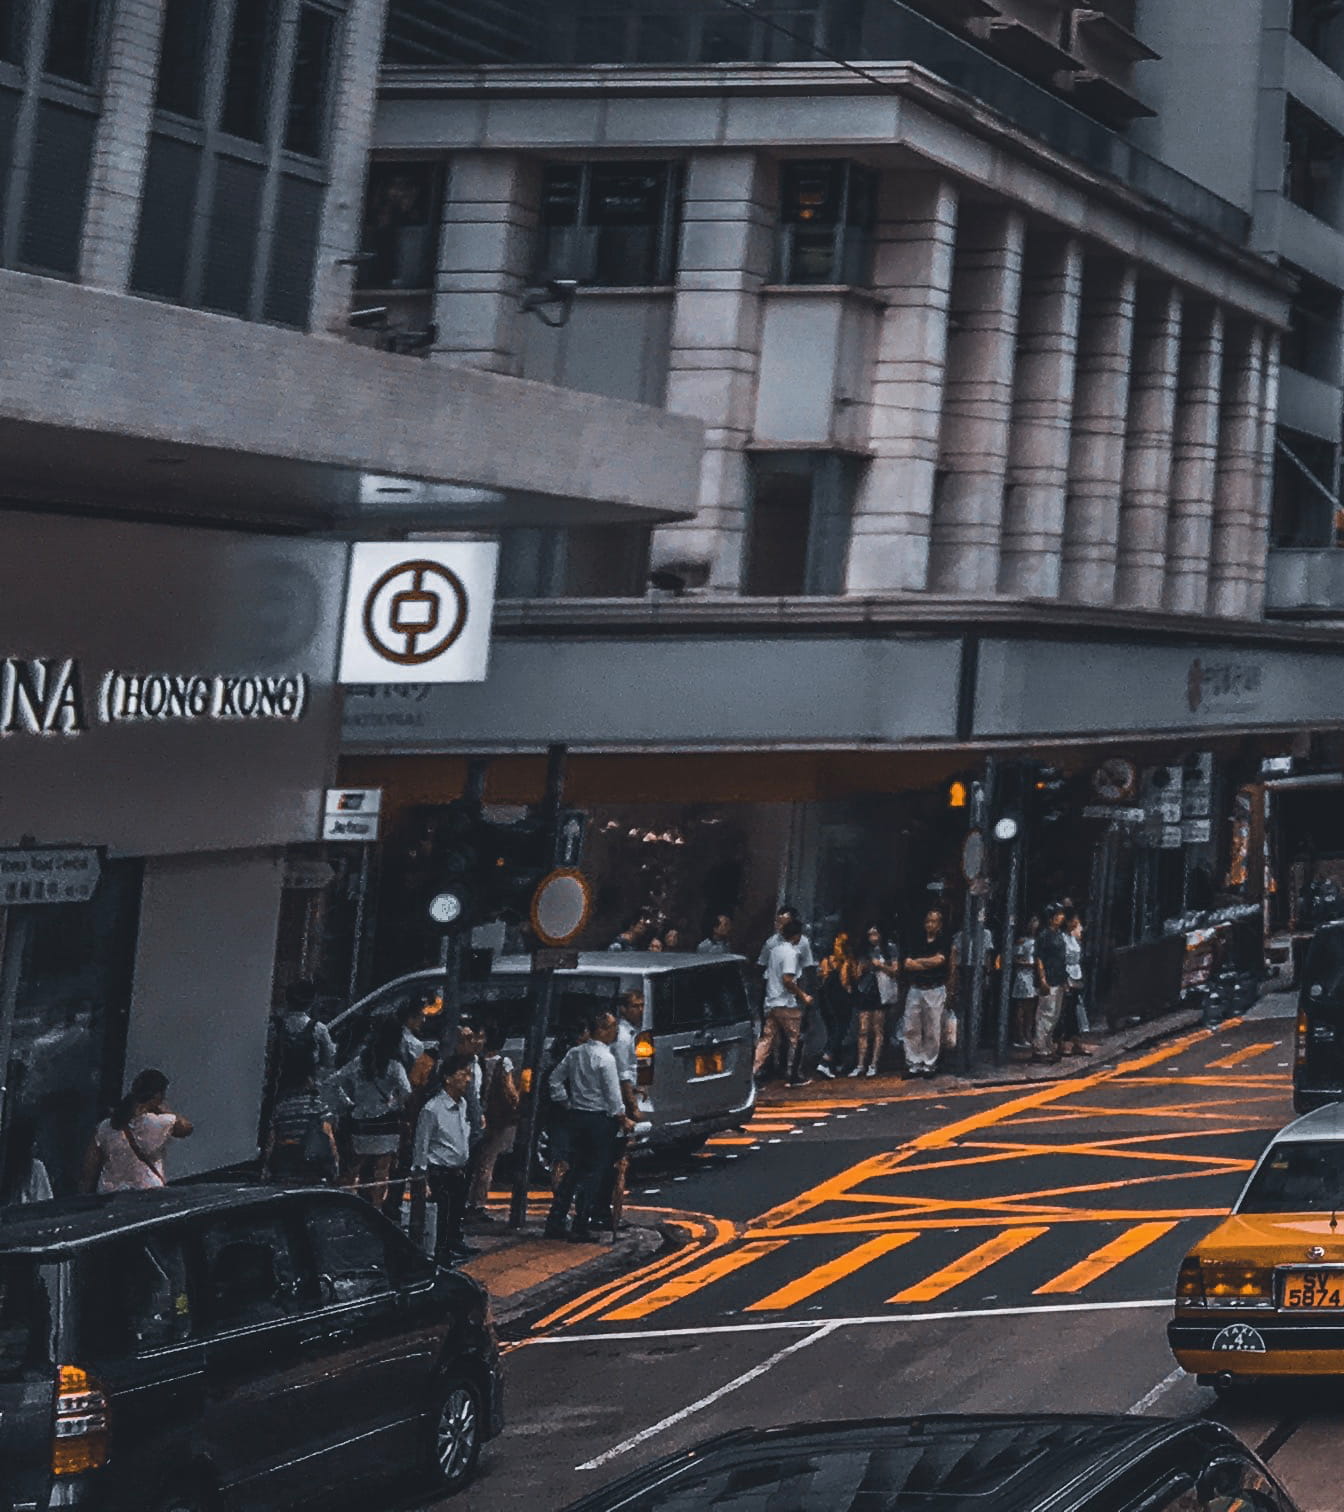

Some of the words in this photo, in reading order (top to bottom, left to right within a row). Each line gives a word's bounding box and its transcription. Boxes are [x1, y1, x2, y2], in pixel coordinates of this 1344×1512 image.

[98, 669, 210, 723] (HONG
[214, 672, 310, 722] KONG)
[1303, 1273, 1329, 1290] SV
[1289, 1289, 1341, 1307] 5874
[1223, 1326, 1255, 1338] TAXI
[1233, 1333, 1244, 1345] 4
